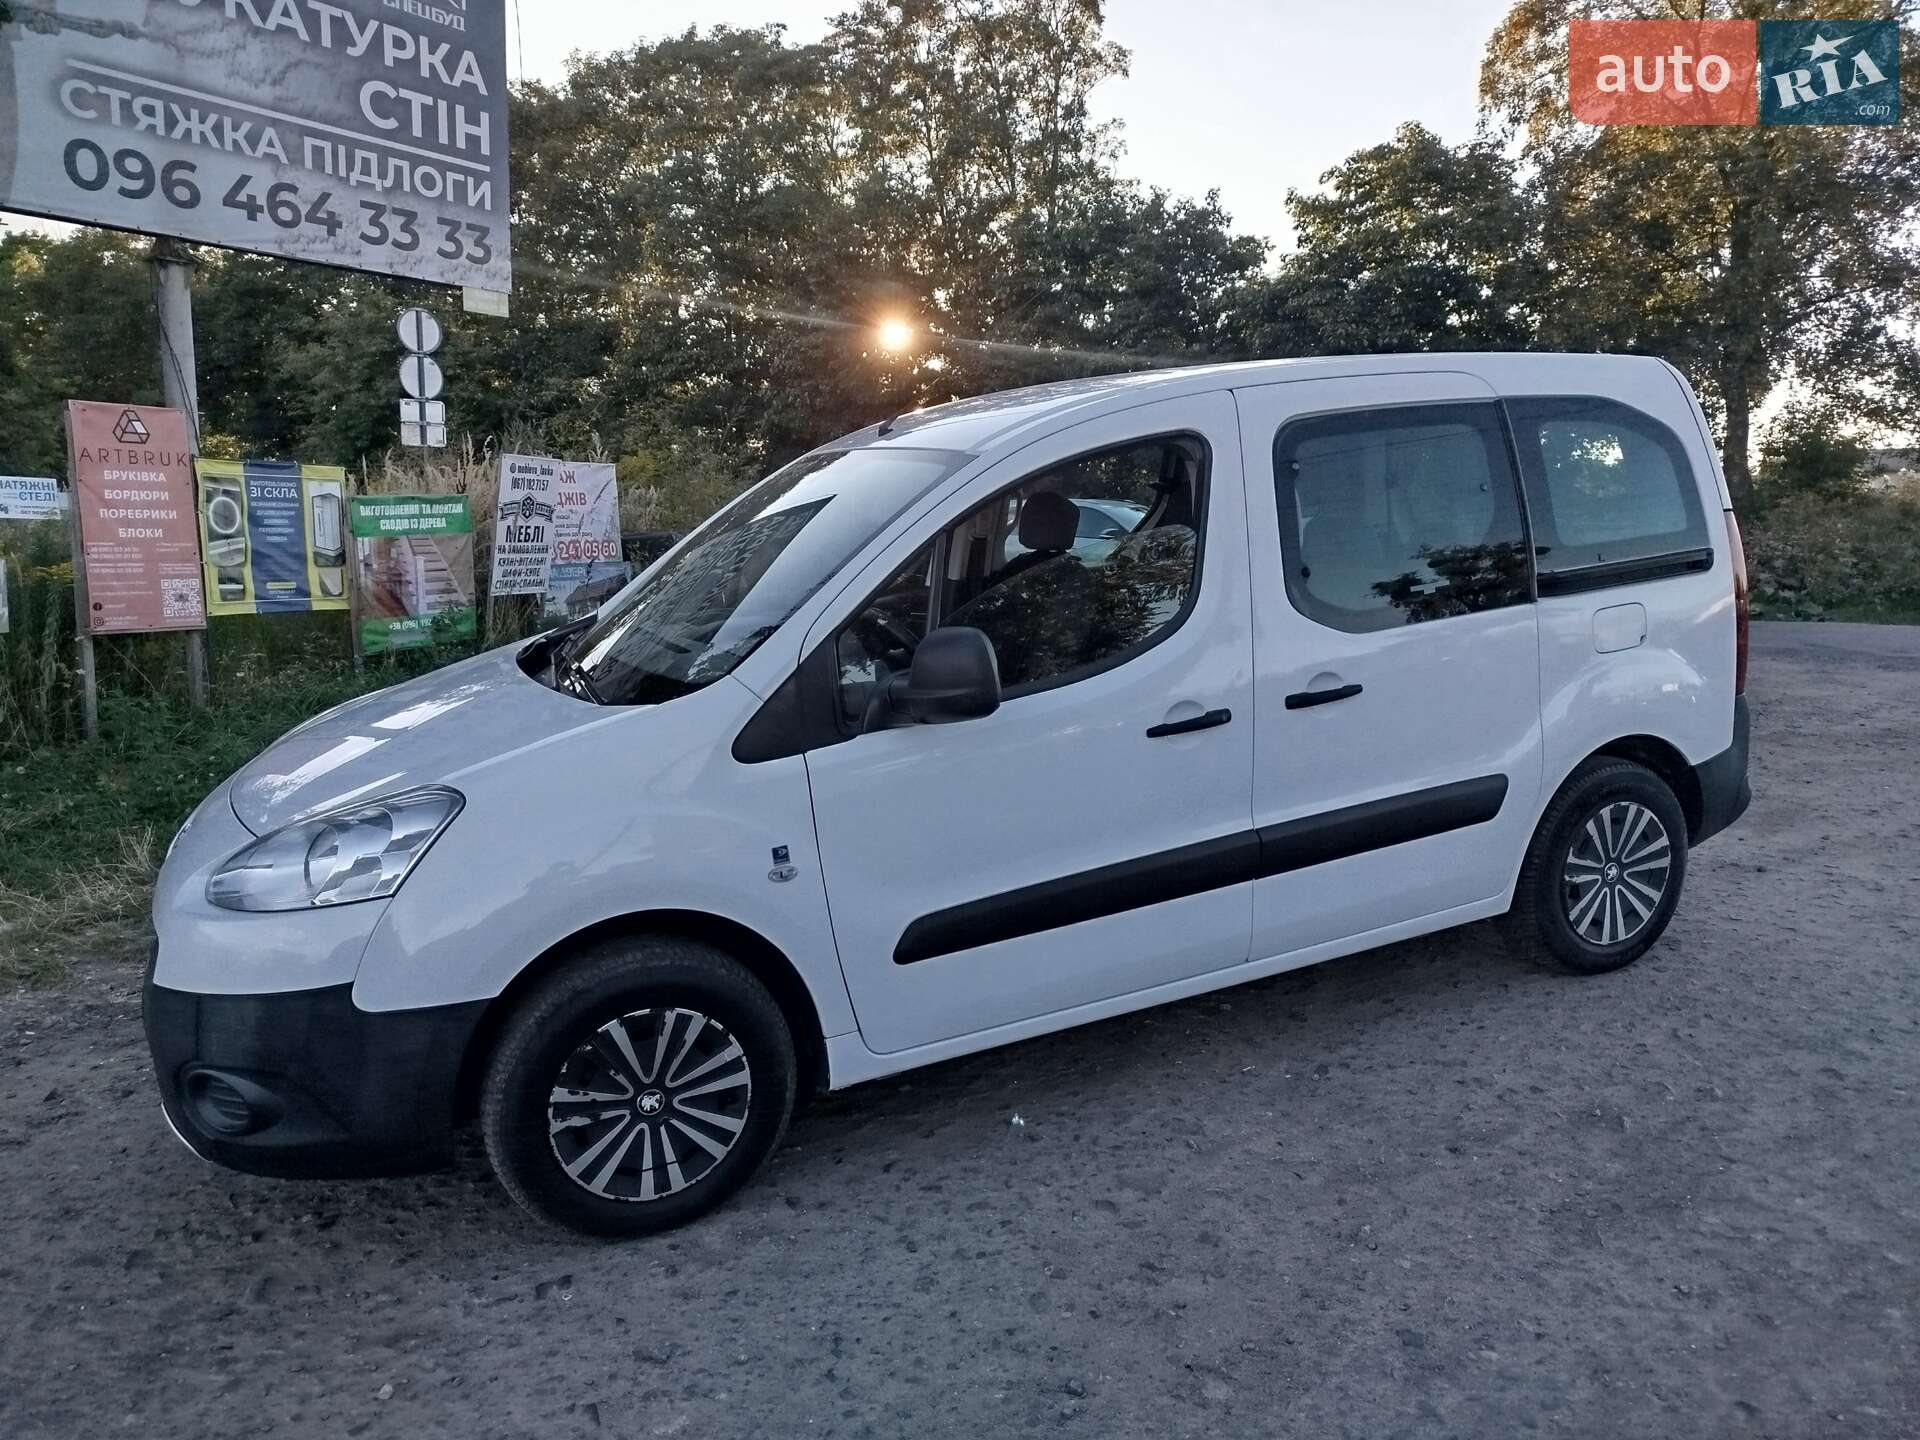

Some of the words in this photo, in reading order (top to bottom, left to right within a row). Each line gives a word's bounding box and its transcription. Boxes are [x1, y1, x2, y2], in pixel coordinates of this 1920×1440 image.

[178, 0, 490, 96] КАТУРКА
[359, 80, 492, 156] СТІН
[60, 79, 289, 165] СТЯЖКА
[303, 135, 493, 211] ПІДЛОГИ
[63, 138, 201, 209] 096
[222, 174, 343, 237] 464
[359, 200, 421, 252] 33
[436, 216, 493, 265] 33
[79, 447, 187, 467] ARTBRUK
[103, 470, 167, 482] БРУКІВКА
[19, 491, 56, 502] СТЕЛІ
[104, 489, 169, 501] БОРДЮРИ
[250, 486, 261, 497] ЗІ
[264, 487, 298, 498] СКЛА
[99, 508, 177, 519] ПОРЕБРИКИ
[380, 519, 409, 531] СХОДІВ
[420, 517, 446, 530] ДЕРЕВА
[118, 528, 163, 538] БЛОКИ
[505, 525, 544, 543] МЕБЛІ
[584, 541, 600, 559] 05
[601, 540, 618, 558] 60
